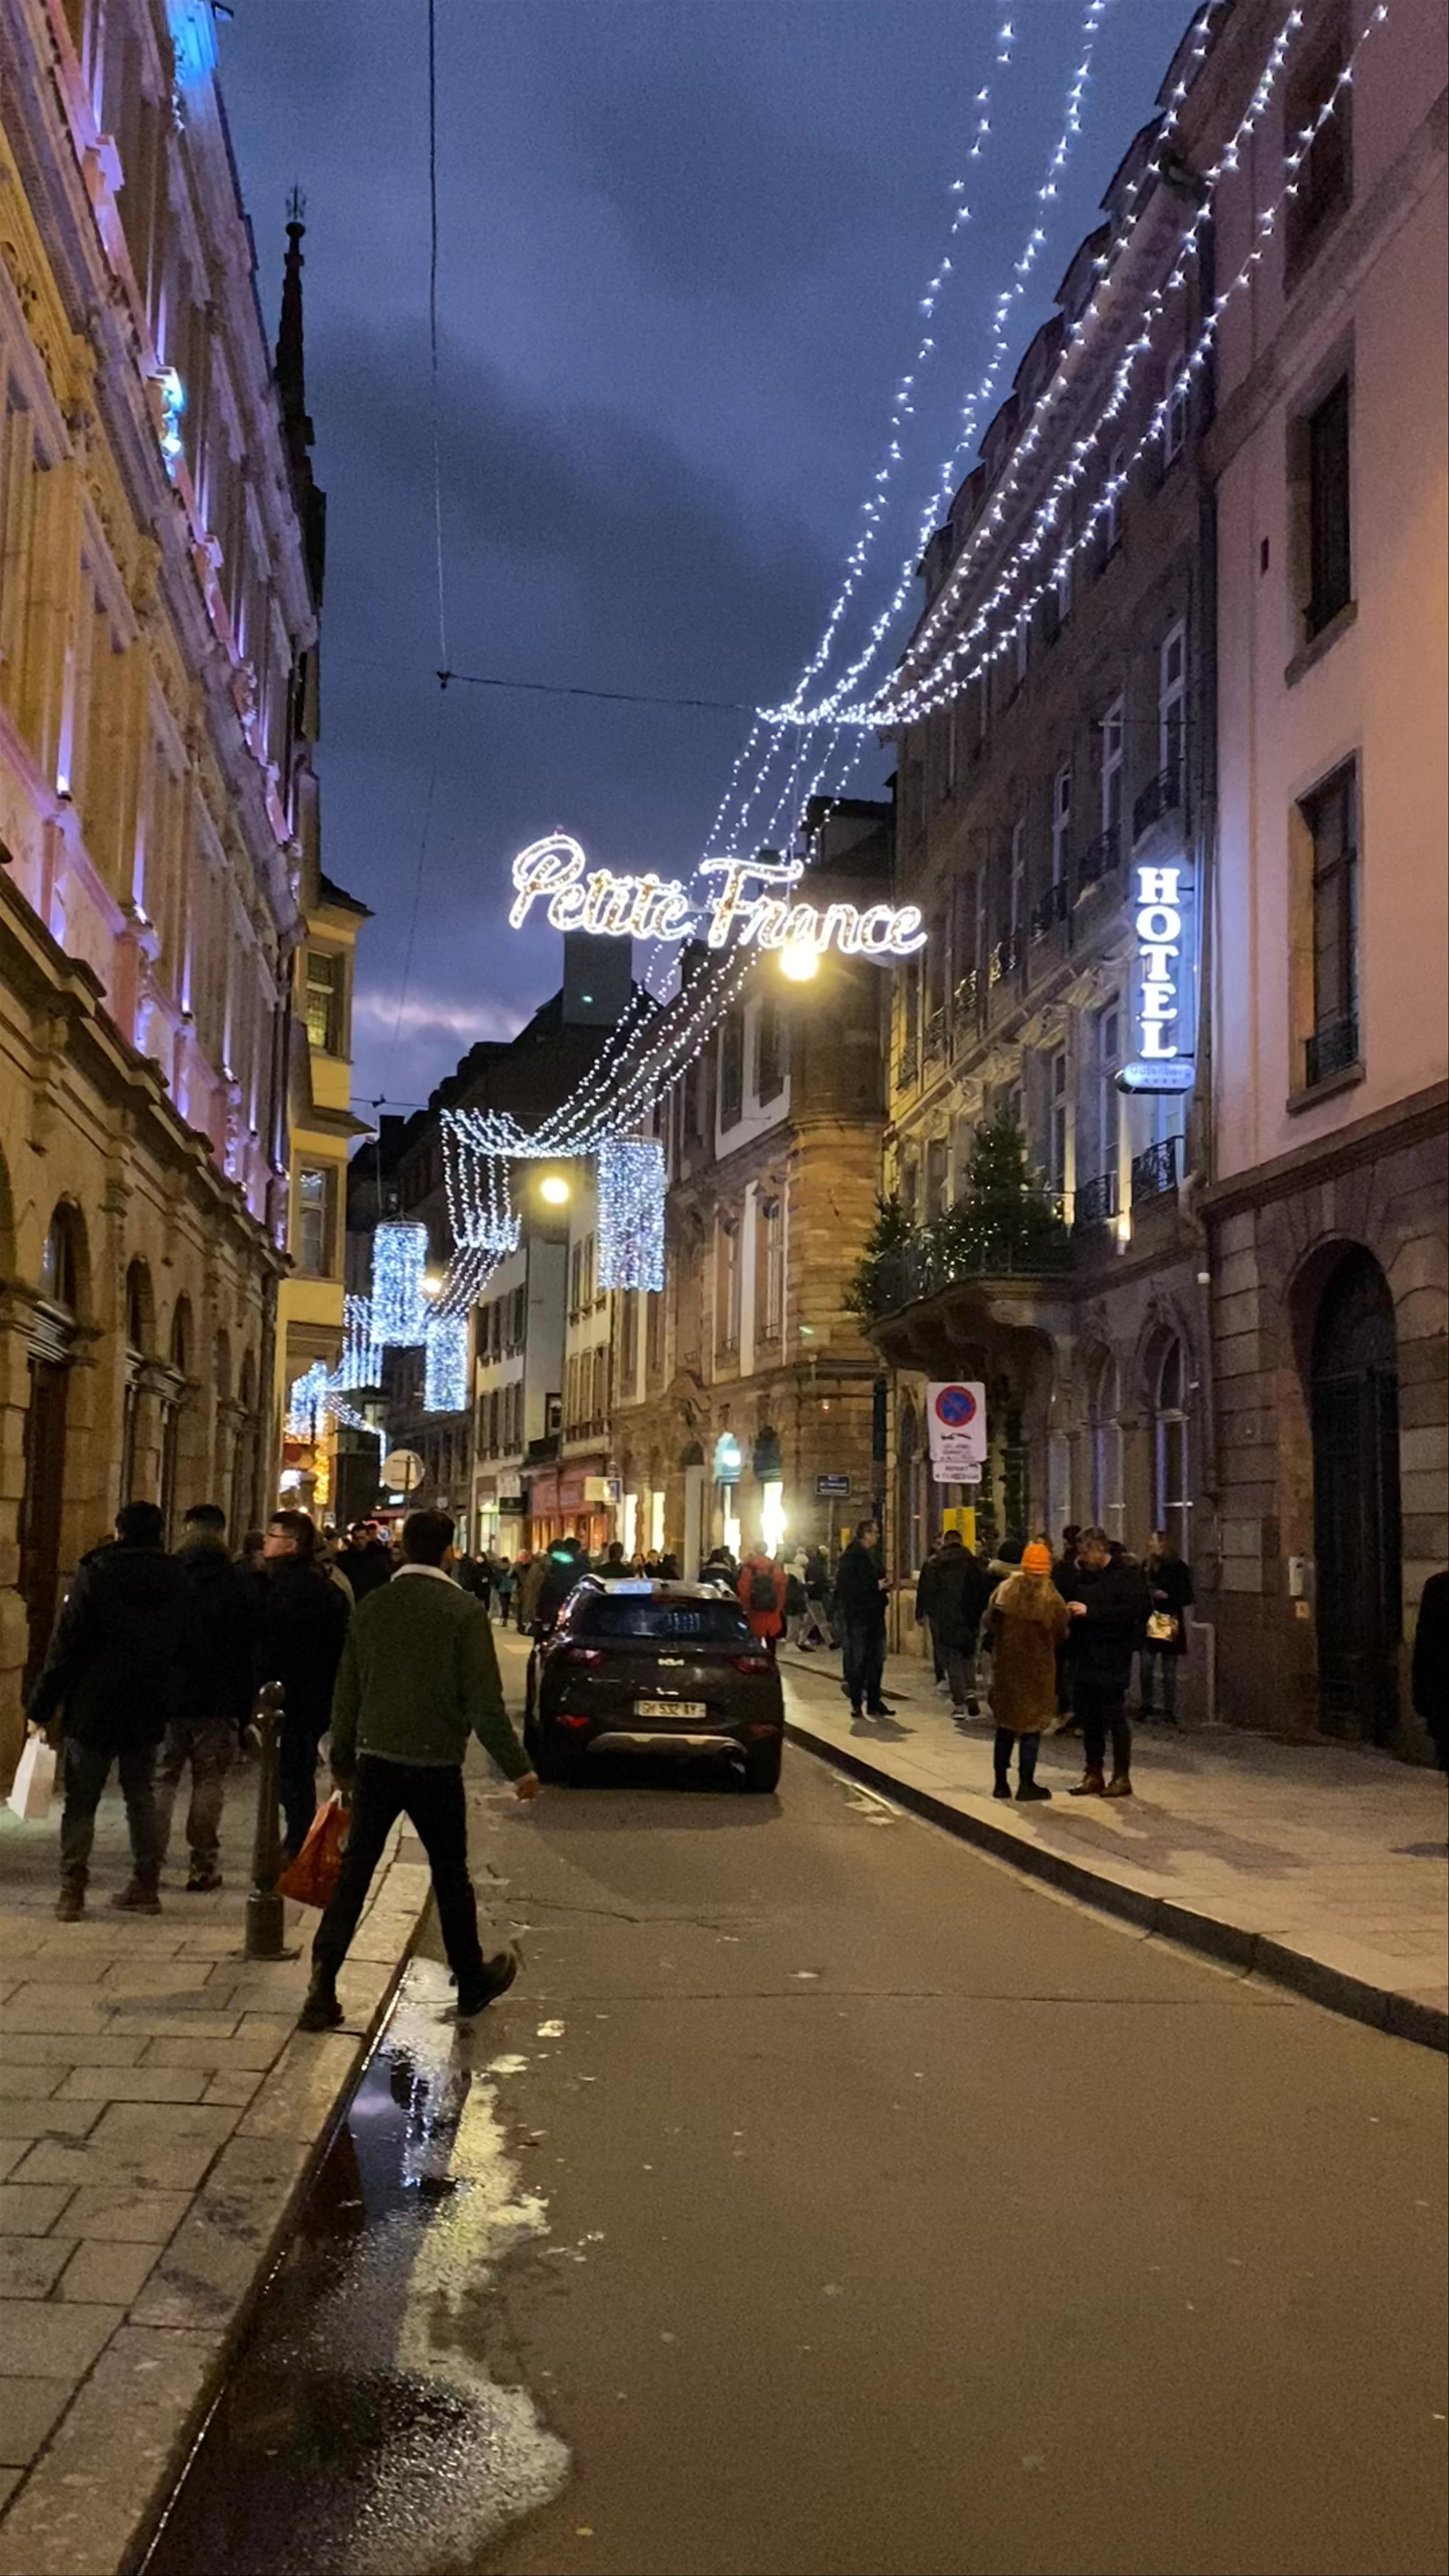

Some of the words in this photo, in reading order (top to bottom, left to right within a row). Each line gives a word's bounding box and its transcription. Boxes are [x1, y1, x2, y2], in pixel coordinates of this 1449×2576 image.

[509, 832, 695, 941] Petite
[700, 858, 928, 954] France
[1135, 867, 1181, 1058] HOTEL
